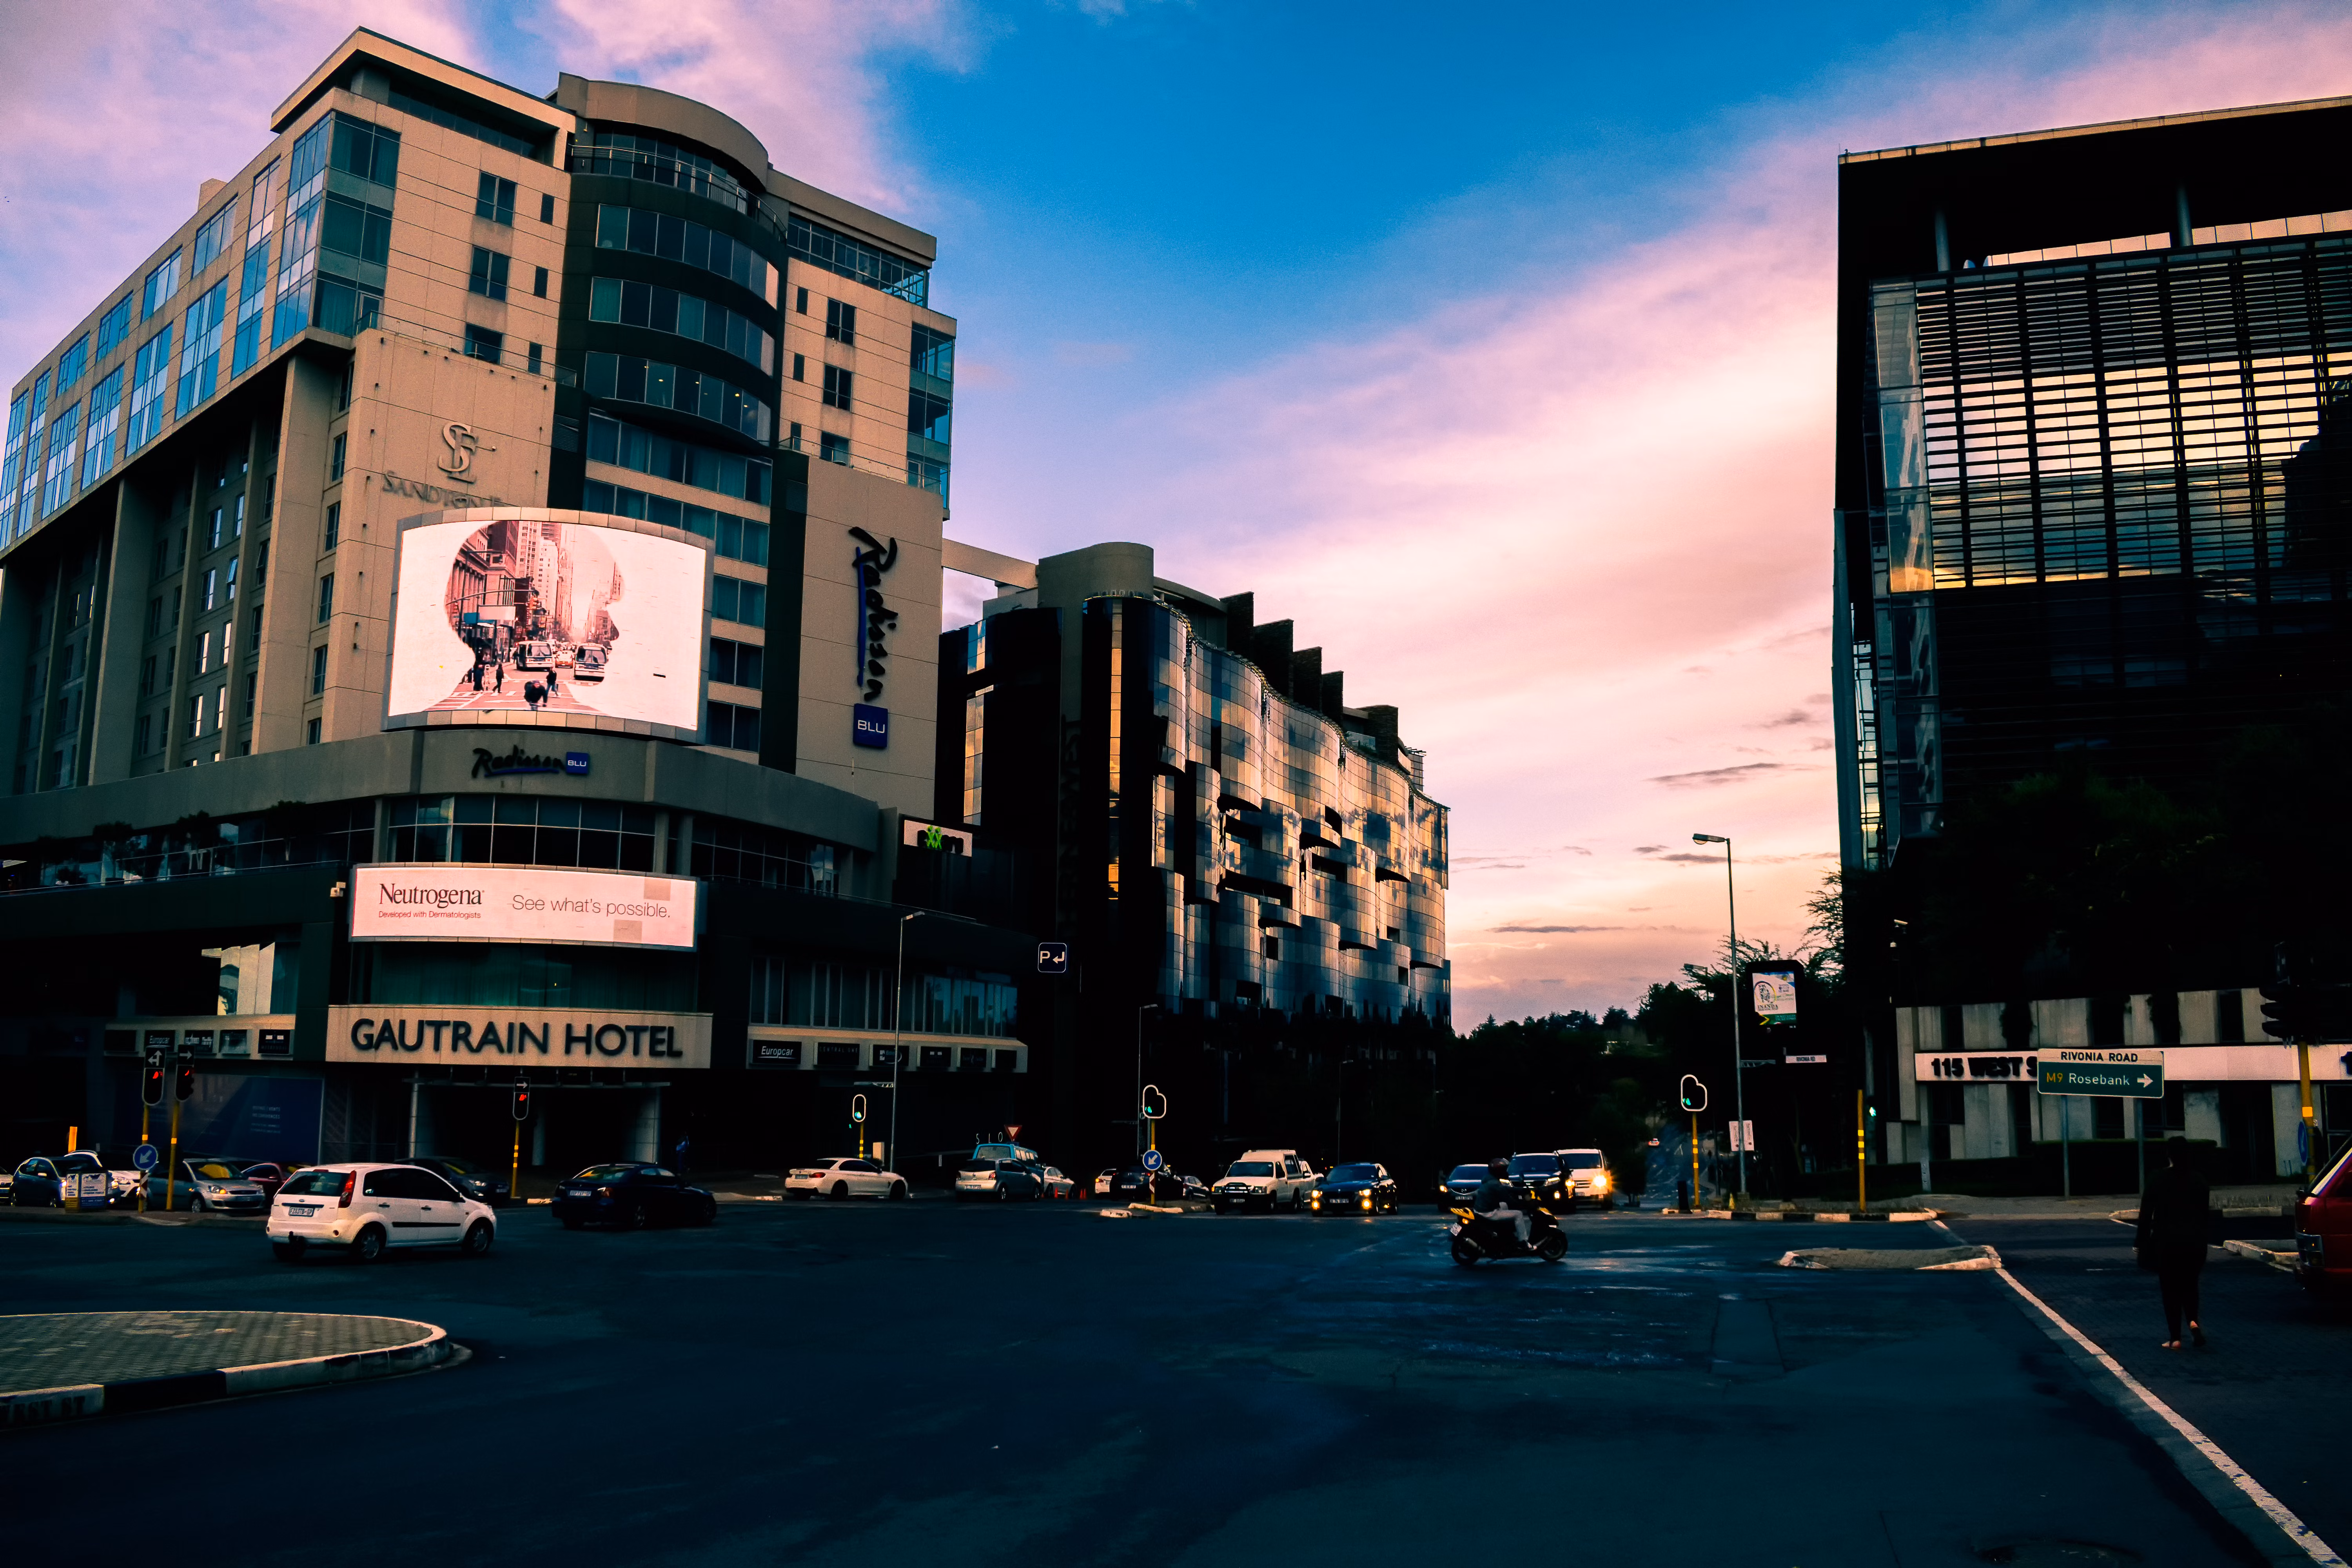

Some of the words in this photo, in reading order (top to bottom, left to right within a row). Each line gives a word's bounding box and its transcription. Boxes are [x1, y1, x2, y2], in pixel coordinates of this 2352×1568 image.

[849, 526, 898, 702] Radisson
[857, 720, 885, 733] BLU
[471, 744, 566, 779] Radisson
[379, 883, 483, 909] Neutrogena
[512, 895, 545, 911] See
[550, 897, 601, 913] what's
[606, 902, 671, 918] possible.
[428, 911, 481, 920] Dermatologists
[1039, 951, 1051, 964] P
[350, 1018, 548, 1054] GAUTRAIN
[564, 1023, 683, 1057] HOTEL
[761, 1045, 794, 1058] Europcar
[2061, 1051, 2104, 1061] RIVONIA
[2109, 1053, 2138, 1062] ROAD
[1931, 1058, 1964, 1076] 115
[1967, 1056, 2023, 1076] WEST
[2046, 1072, 2063, 1083] M9
[2069, 1072, 2131, 1085] Rosebank
